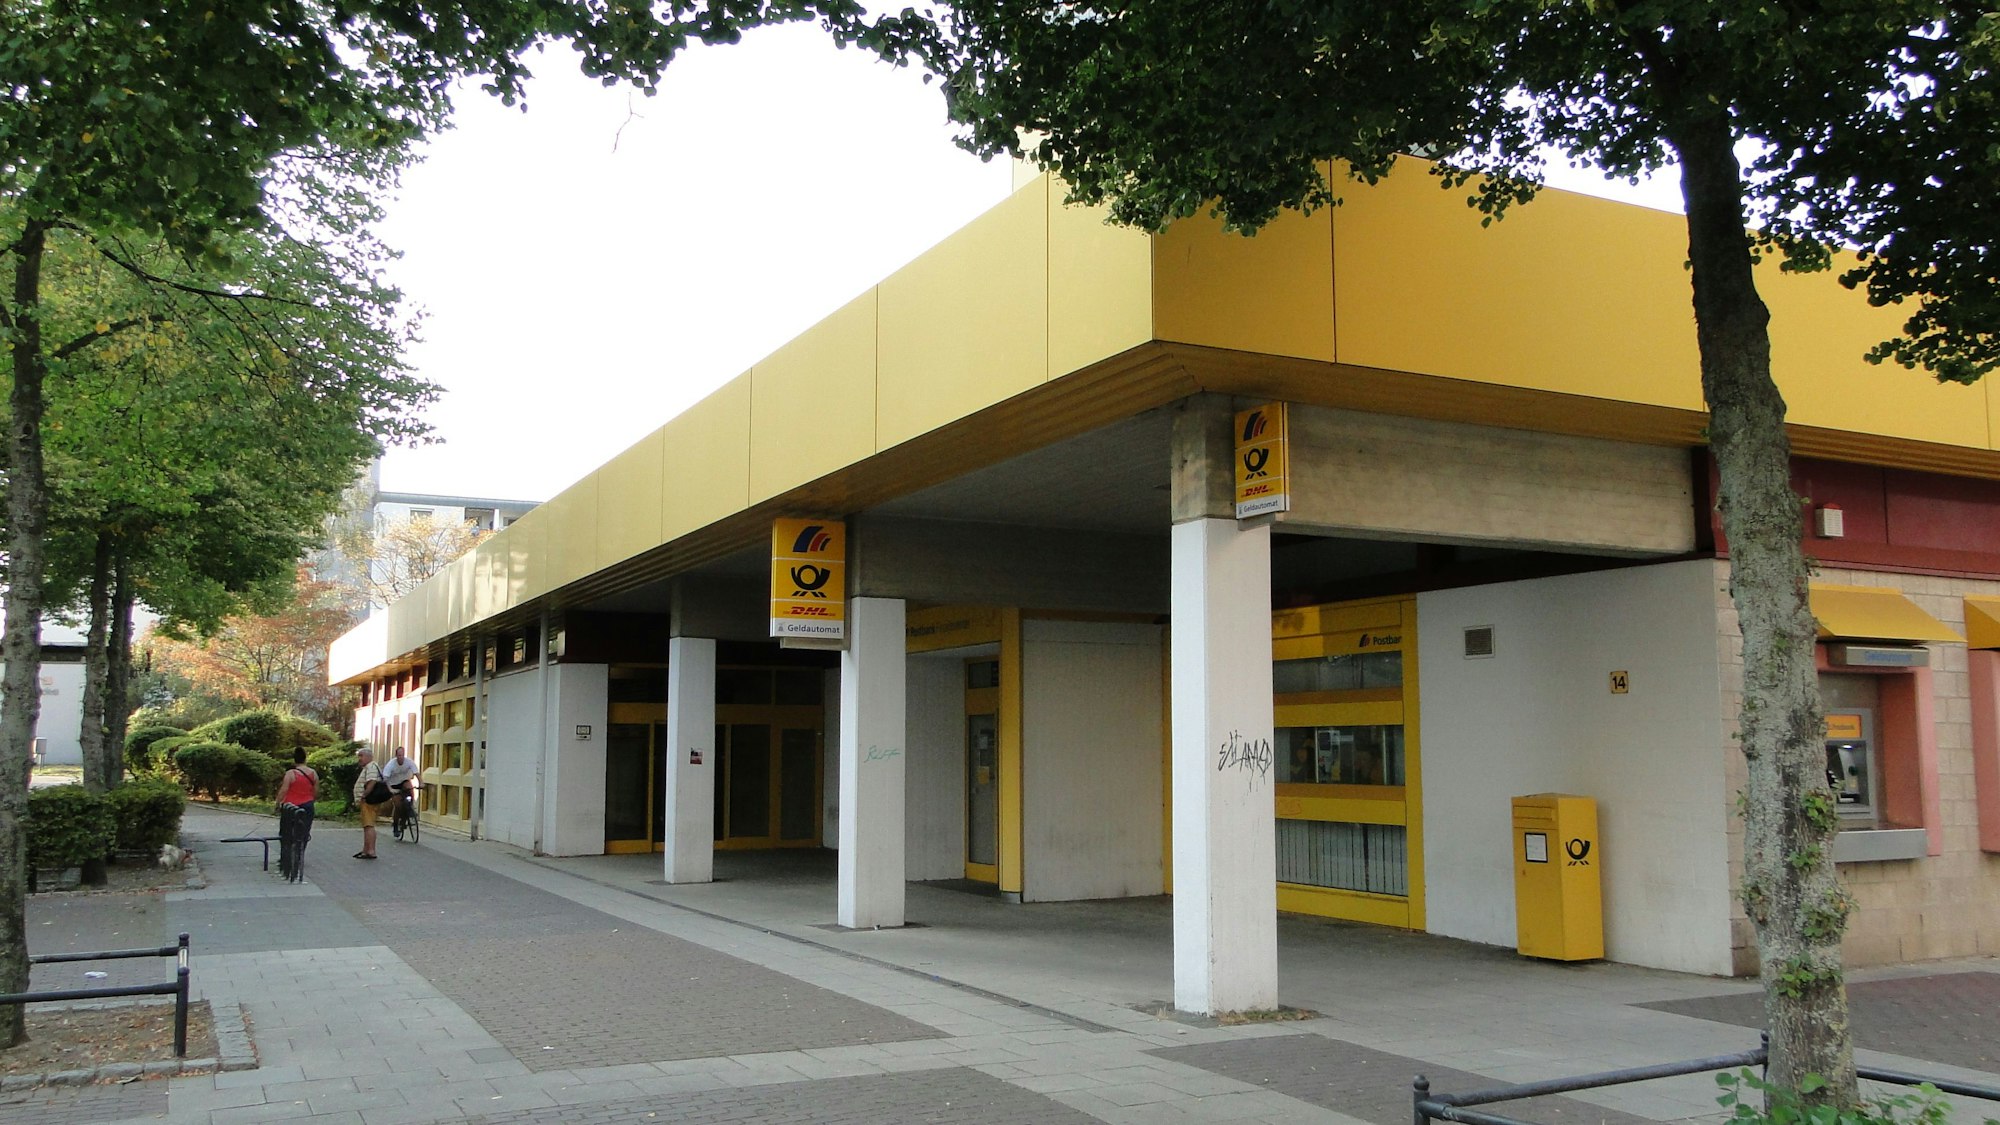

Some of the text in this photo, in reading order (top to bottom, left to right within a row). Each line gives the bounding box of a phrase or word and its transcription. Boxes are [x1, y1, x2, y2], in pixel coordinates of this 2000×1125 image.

[1245, 484, 1268, 496] DHL
[1243, 500, 1278, 513] Geldautomat
[790, 606, 828, 616] DHL
[787, 624, 840, 634] Geldautomat
[1612, 675, 1626, 690] 14
